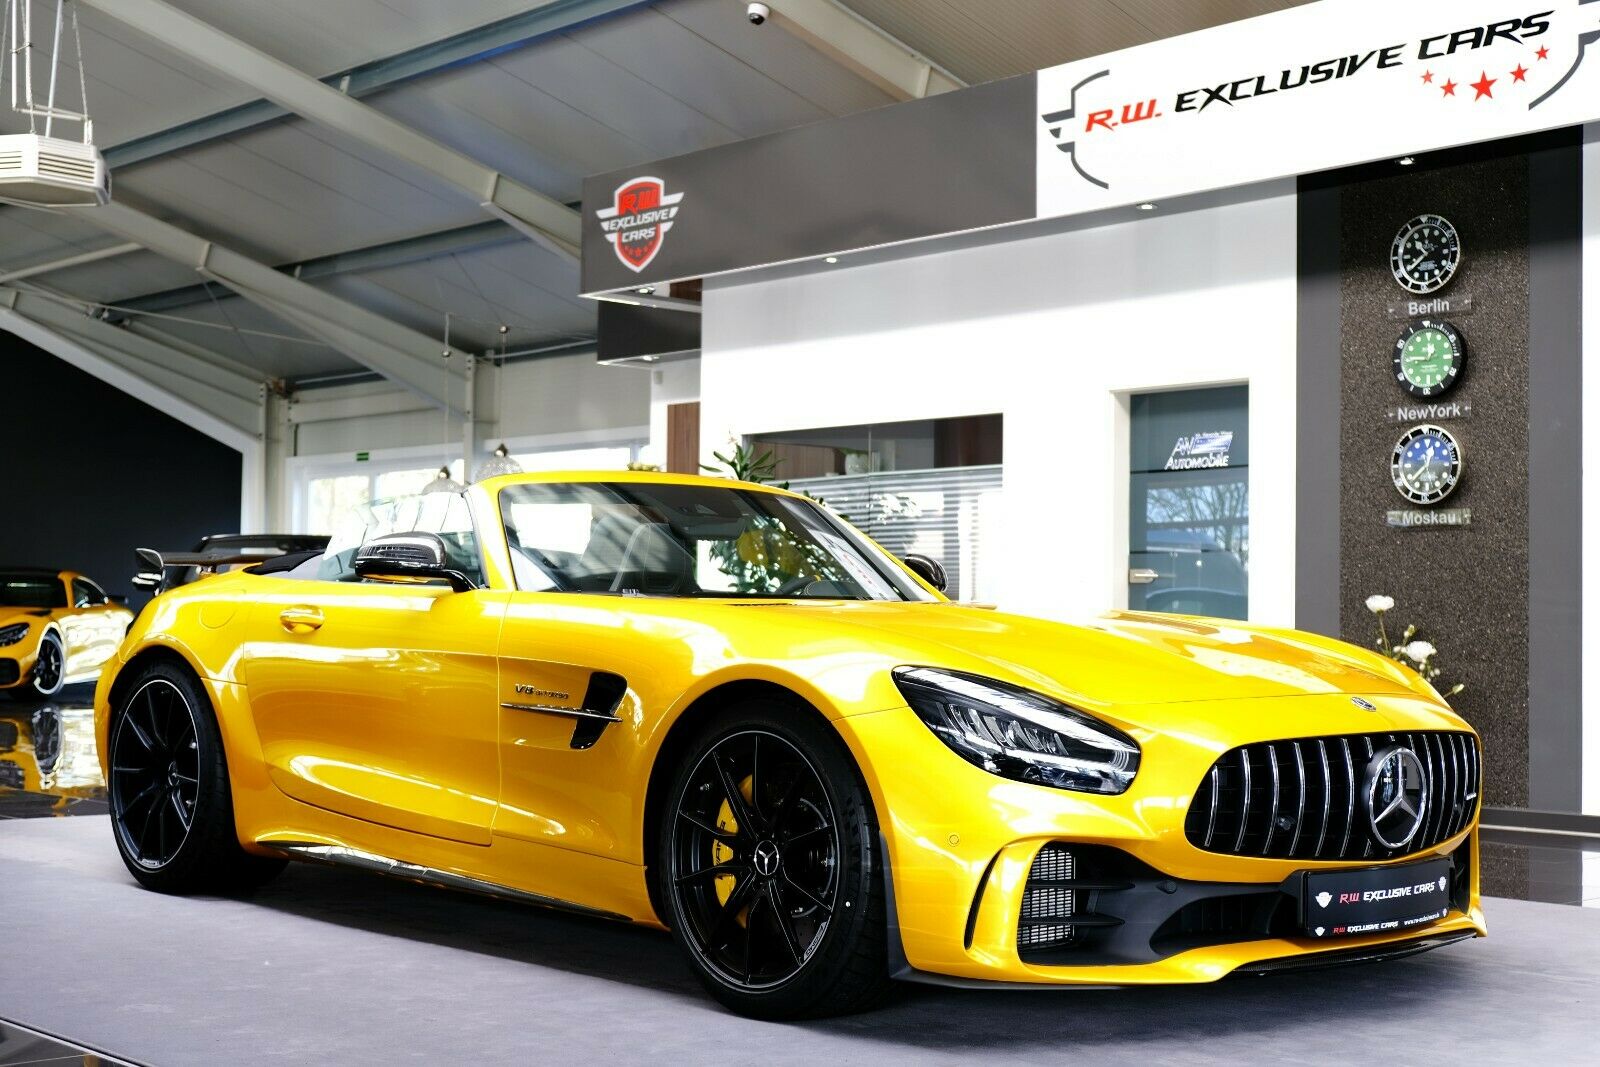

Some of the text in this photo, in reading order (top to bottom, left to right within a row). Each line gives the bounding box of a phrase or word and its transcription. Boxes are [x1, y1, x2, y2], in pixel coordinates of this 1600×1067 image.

[1085, 10, 1556, 132] R.W. EXCLUSIVE CARS
[609, 208, 668, 230] EXCLUSIVE
[622, 227, 656, 243] CARS
[1408, 298, 1450, 316] Berlin
[1397, 402, 1461, 421] NewYork
[1402, 510, 1456, 526] Moskau
[1363, 886, 1412, 903] EXCLUSIVE
[1414, 881, 1436, 894] CARS
